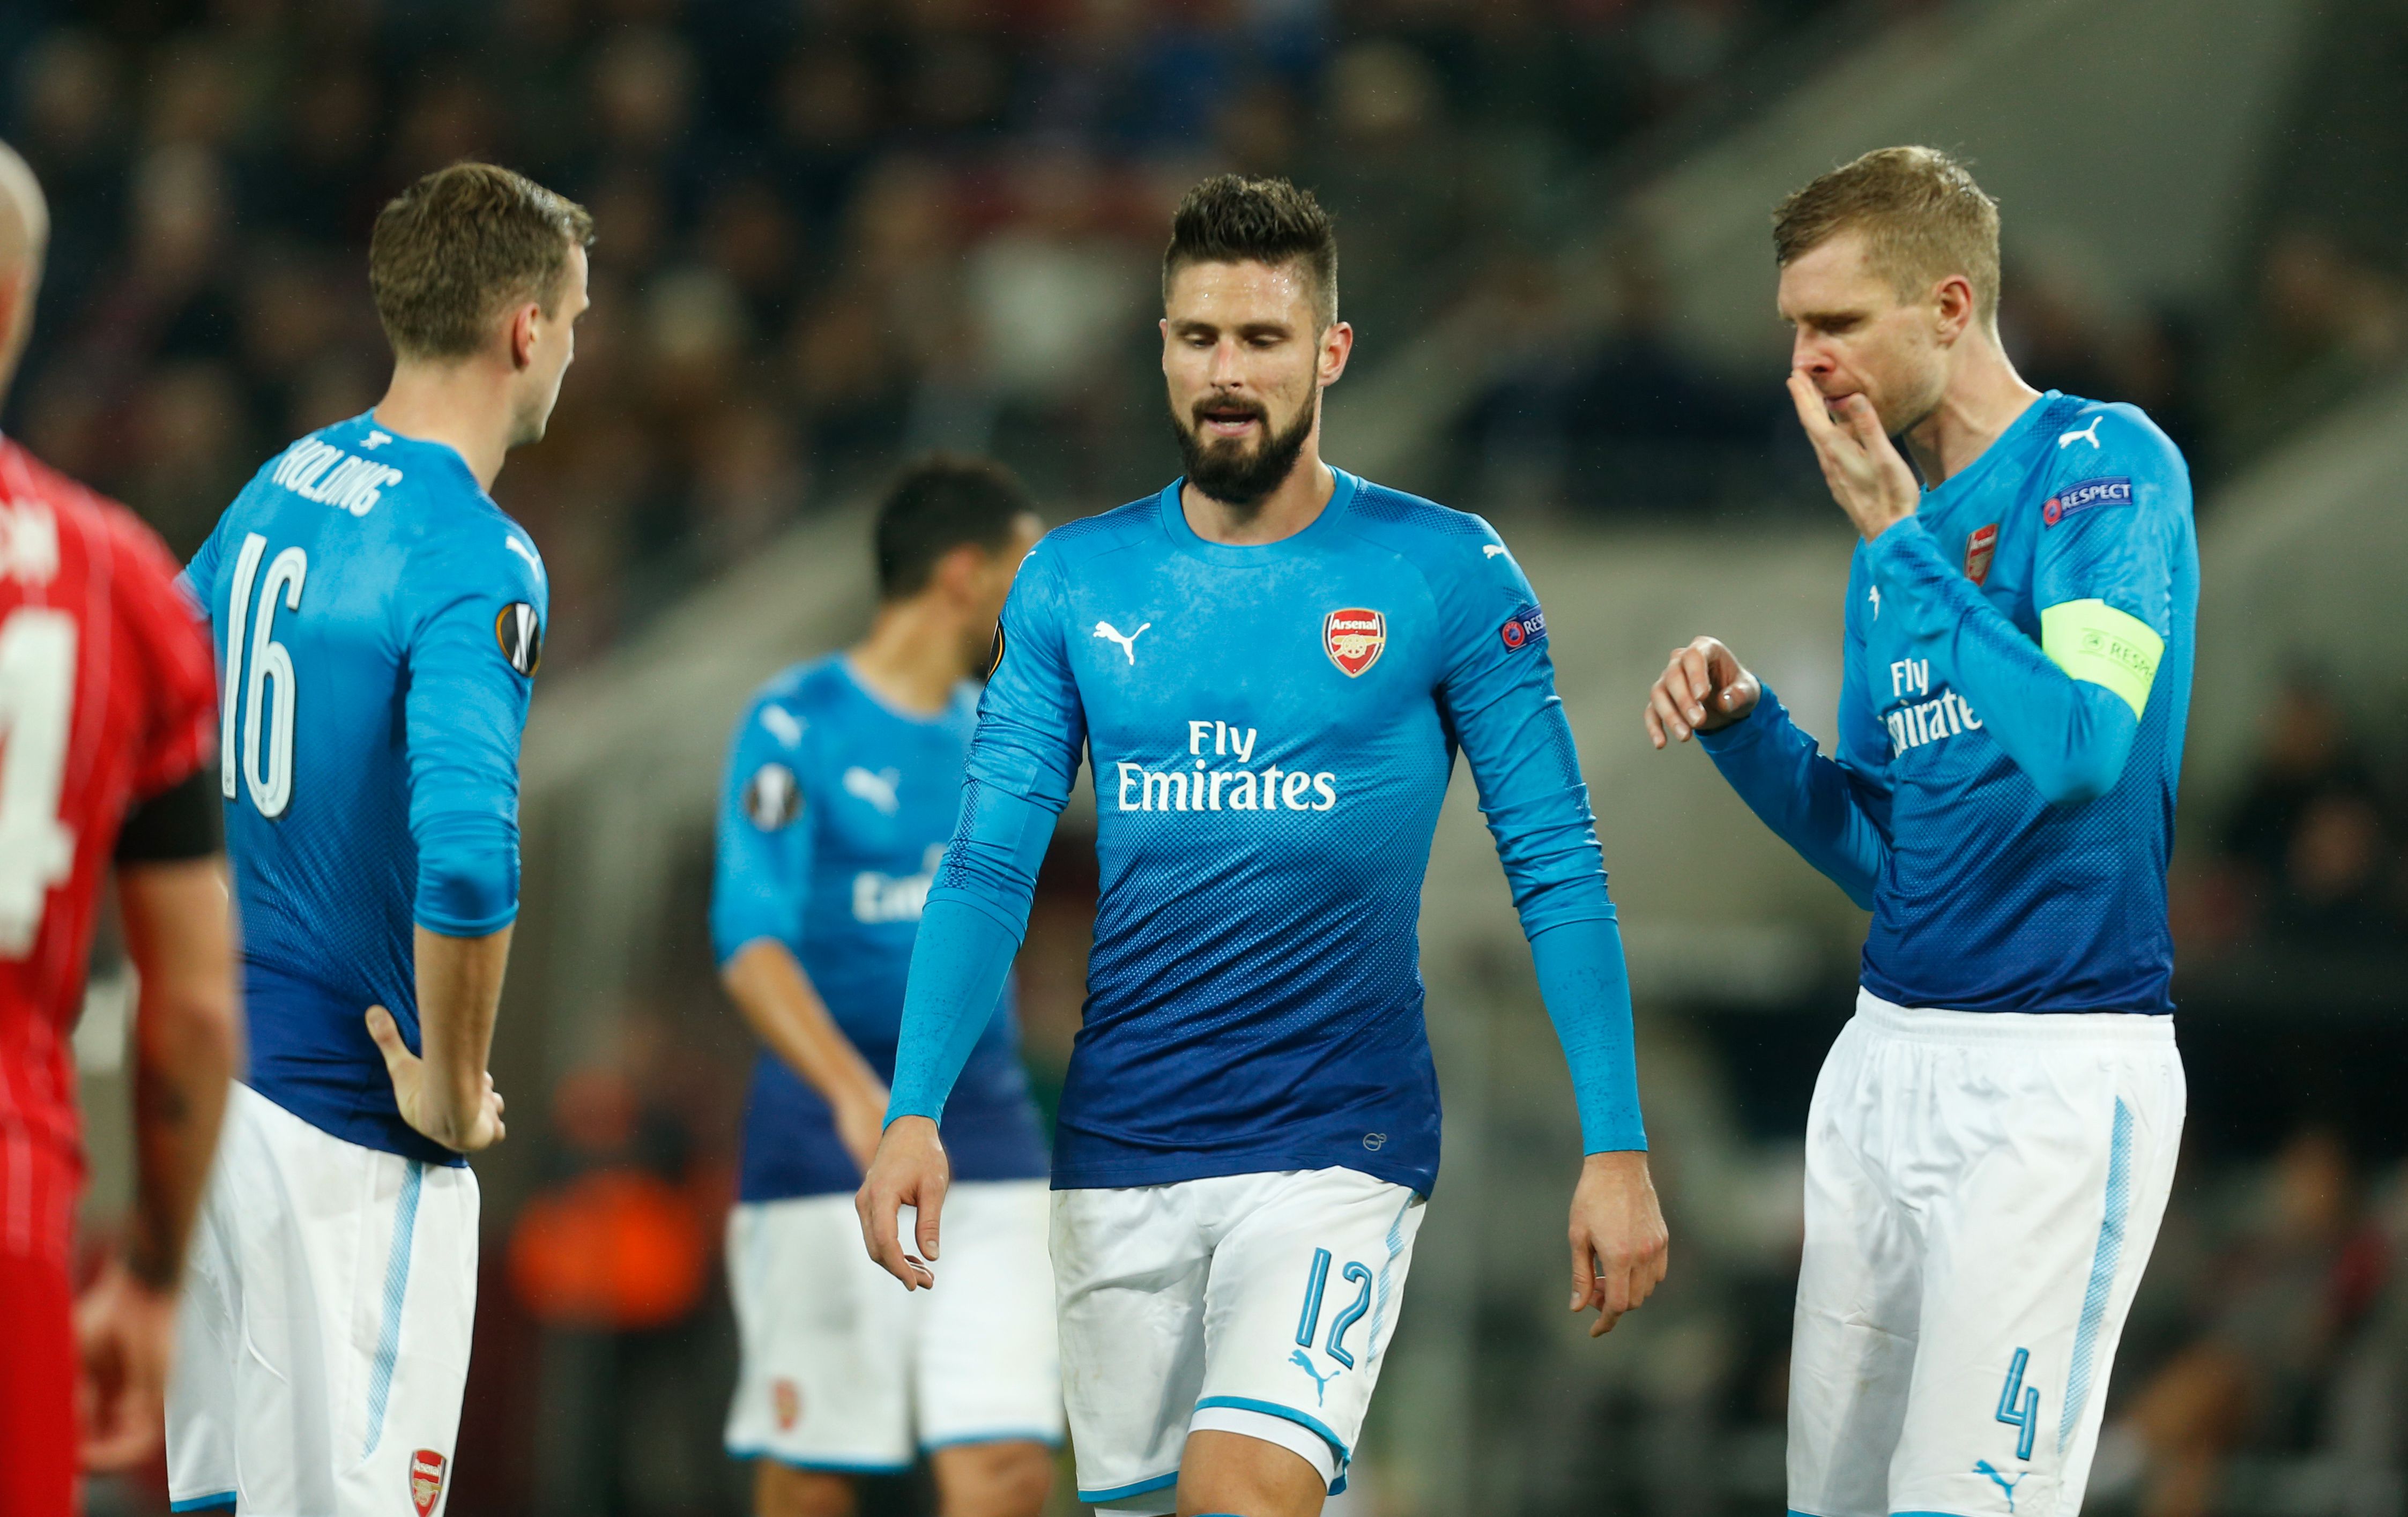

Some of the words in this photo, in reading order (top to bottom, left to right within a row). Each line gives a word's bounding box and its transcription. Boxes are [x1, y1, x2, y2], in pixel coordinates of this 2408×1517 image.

[272, 437, 403, 517] HOLDING
[2061, 484, 2131, 510] RESPECT
[1332, 619, 1377, 630] Arsenal
[221, 532, 307, 819] 16
[1890, 658, 1929, 697] Fly
[1188, 720, 1257, 763] Fly
[1877, 687, 1983, 758] mirate
[1117, 758, 1336, 811] Emirates
[1295, 1247, 1372, 1370] 12
[1996, 1347, 2039, 1461] 4
